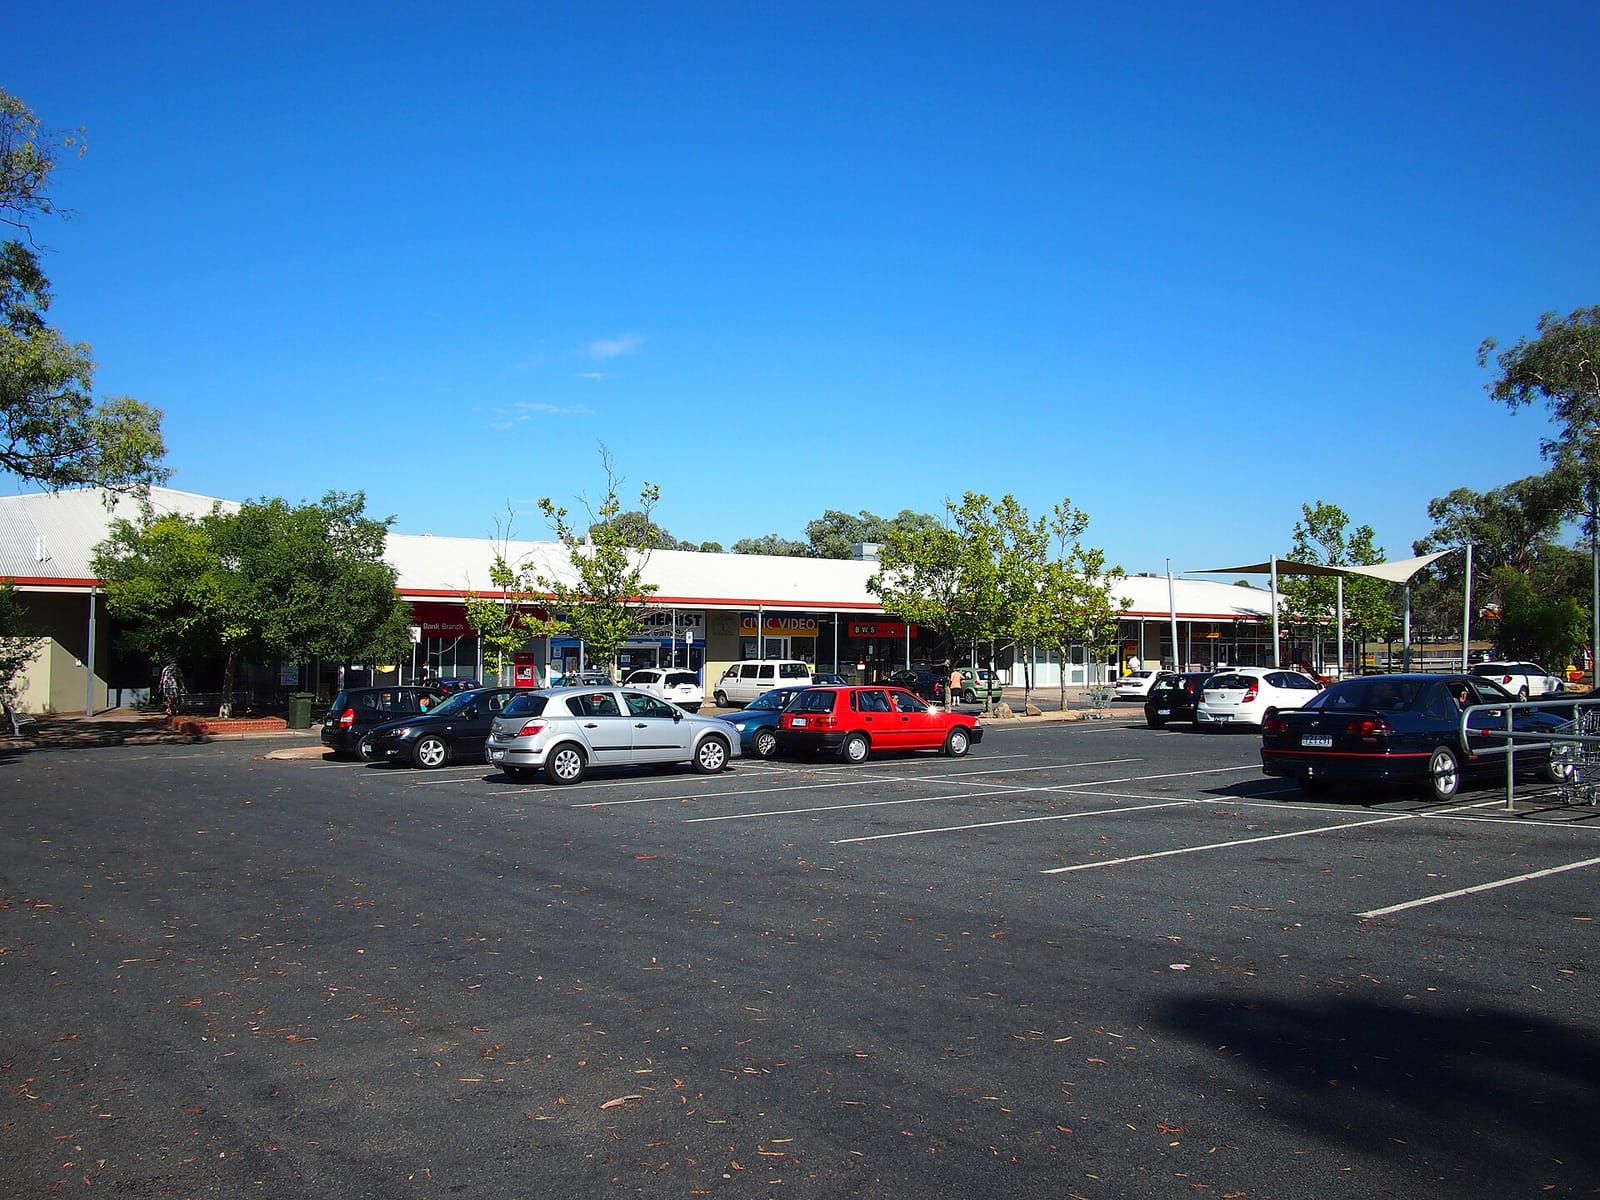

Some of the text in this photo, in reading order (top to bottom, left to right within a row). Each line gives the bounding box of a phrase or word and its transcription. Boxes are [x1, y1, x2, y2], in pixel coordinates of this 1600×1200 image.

[423, 622, 440, 630] Bank
[441, 622, 464, 630] Branch
[777, 618, 816, 630] VIDEO
